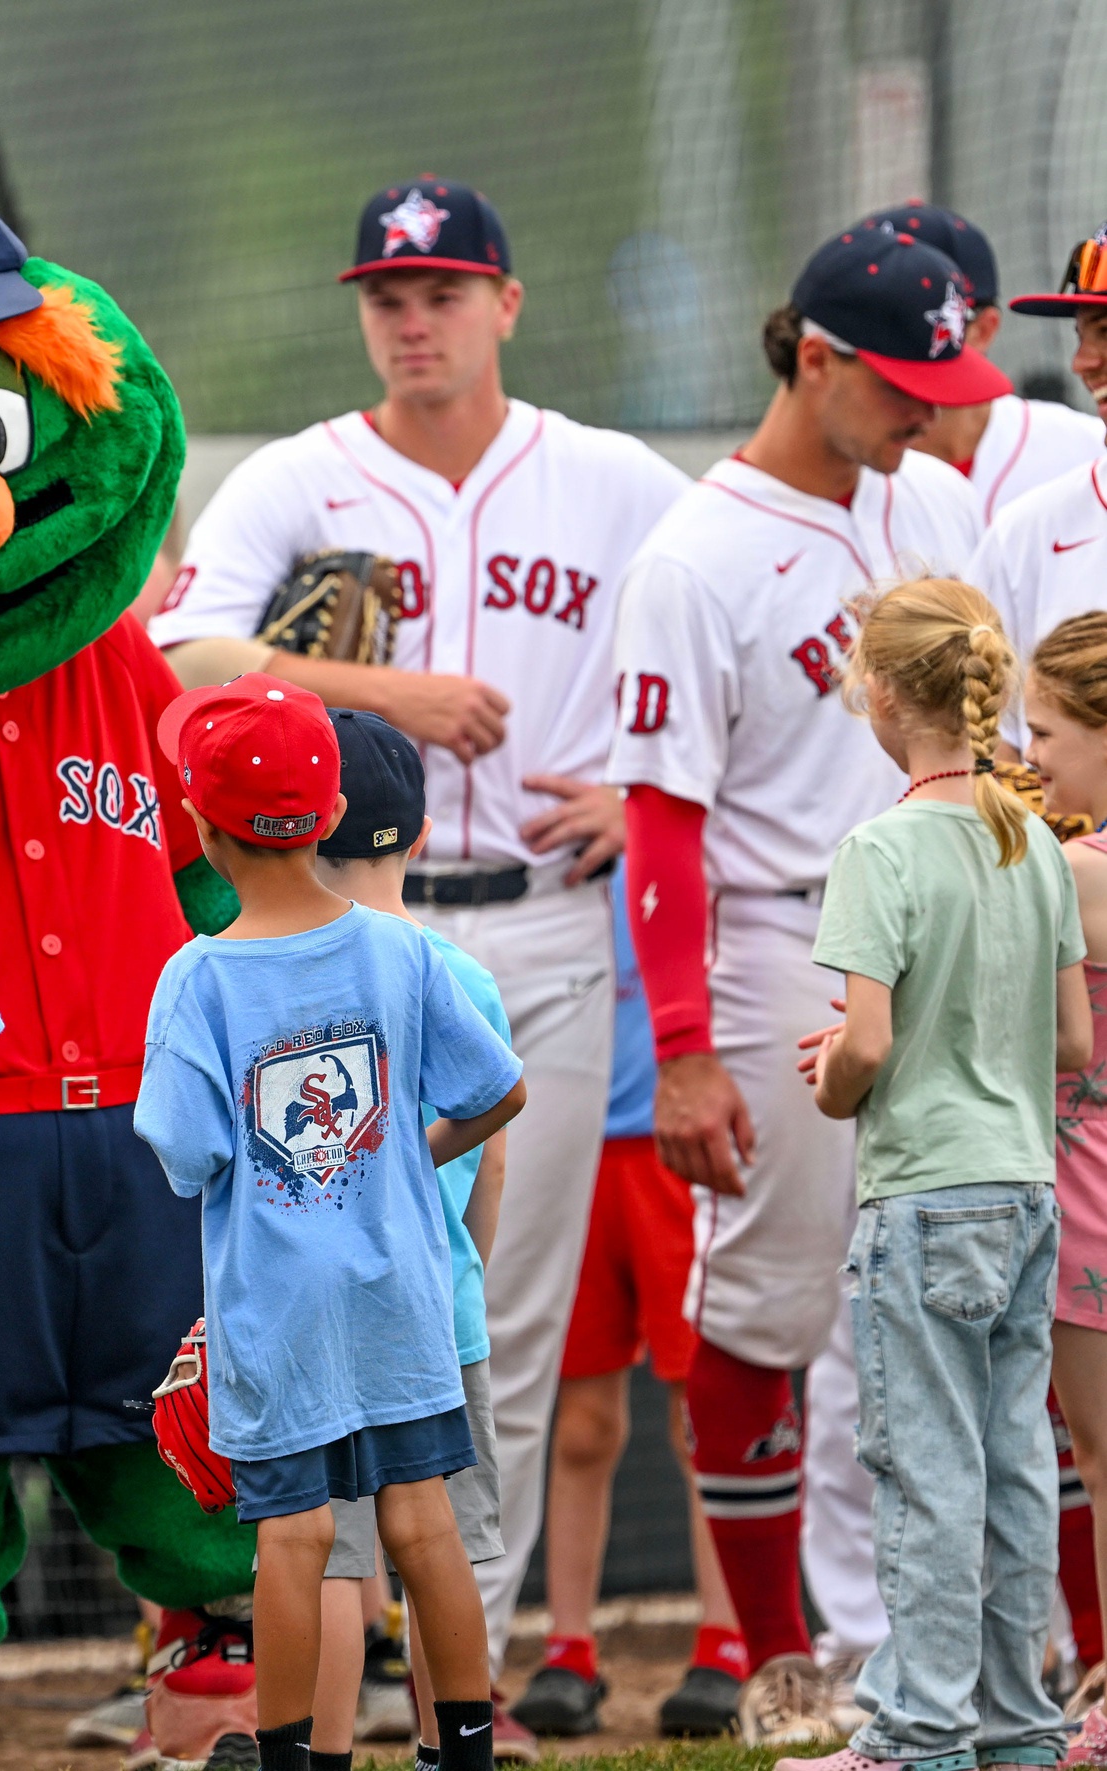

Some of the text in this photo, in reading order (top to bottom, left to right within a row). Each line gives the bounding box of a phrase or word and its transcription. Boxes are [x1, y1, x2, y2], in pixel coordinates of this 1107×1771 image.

[485, 554, 599, 630] SOX
[790, 603, 862, 698] RE
[56, 756, 162, 850] SOX
[260, 1019, 367, 1056] Y-D RED SOX
